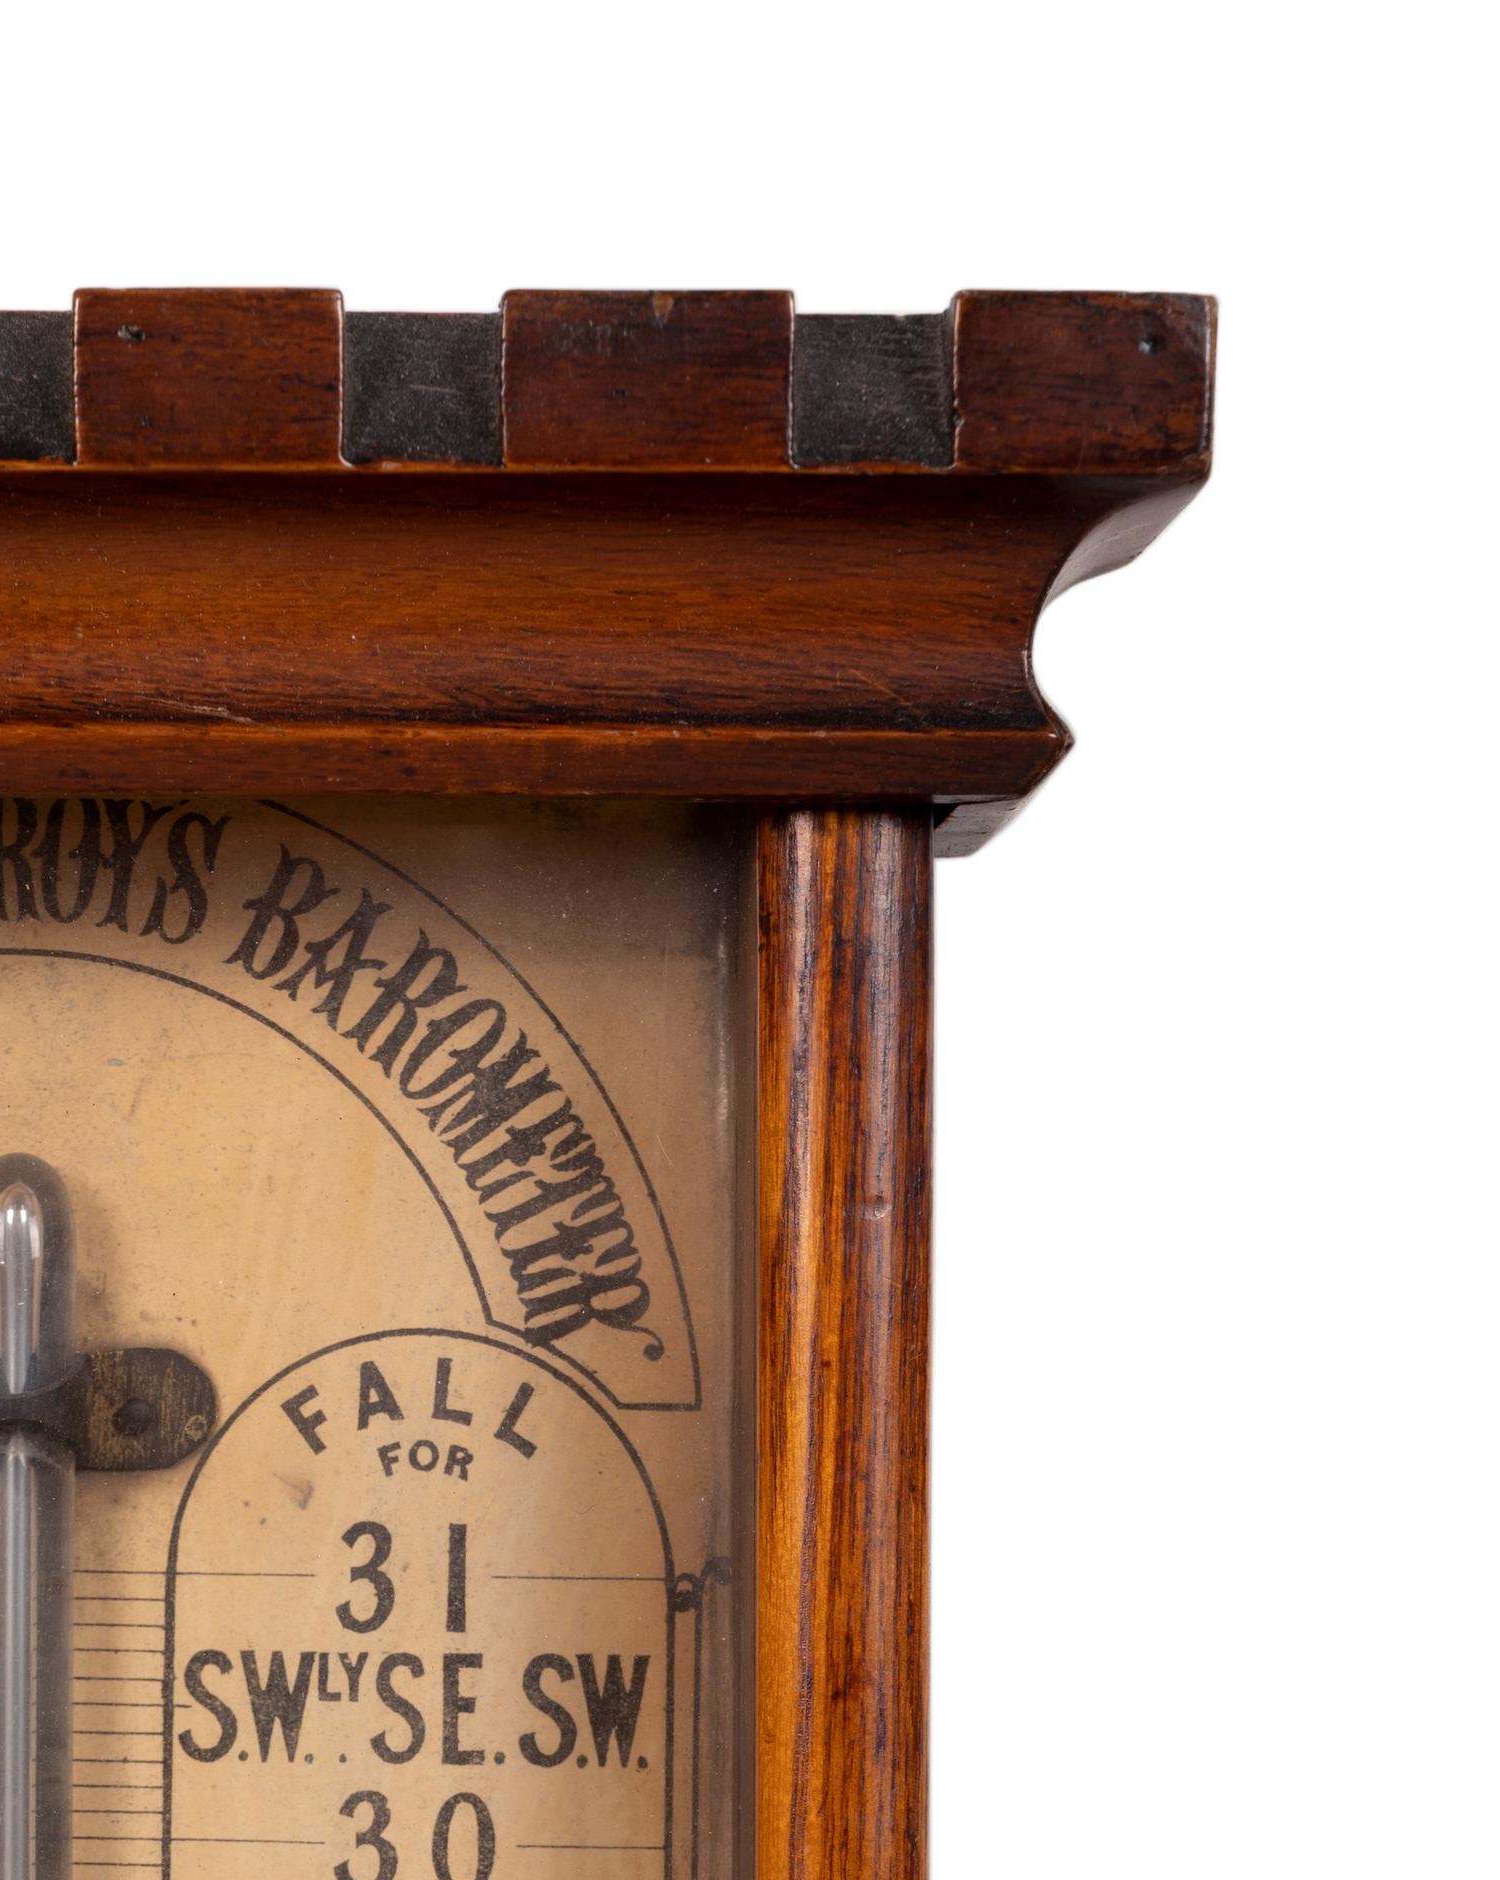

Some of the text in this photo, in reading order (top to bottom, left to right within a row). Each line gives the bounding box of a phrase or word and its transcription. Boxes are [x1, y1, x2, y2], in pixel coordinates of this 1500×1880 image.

[222, 844, 663, 1360] BAROMETER
[280, 1358, 537, 1458] FALL
[378, 1440, 474, 1479] FOR
